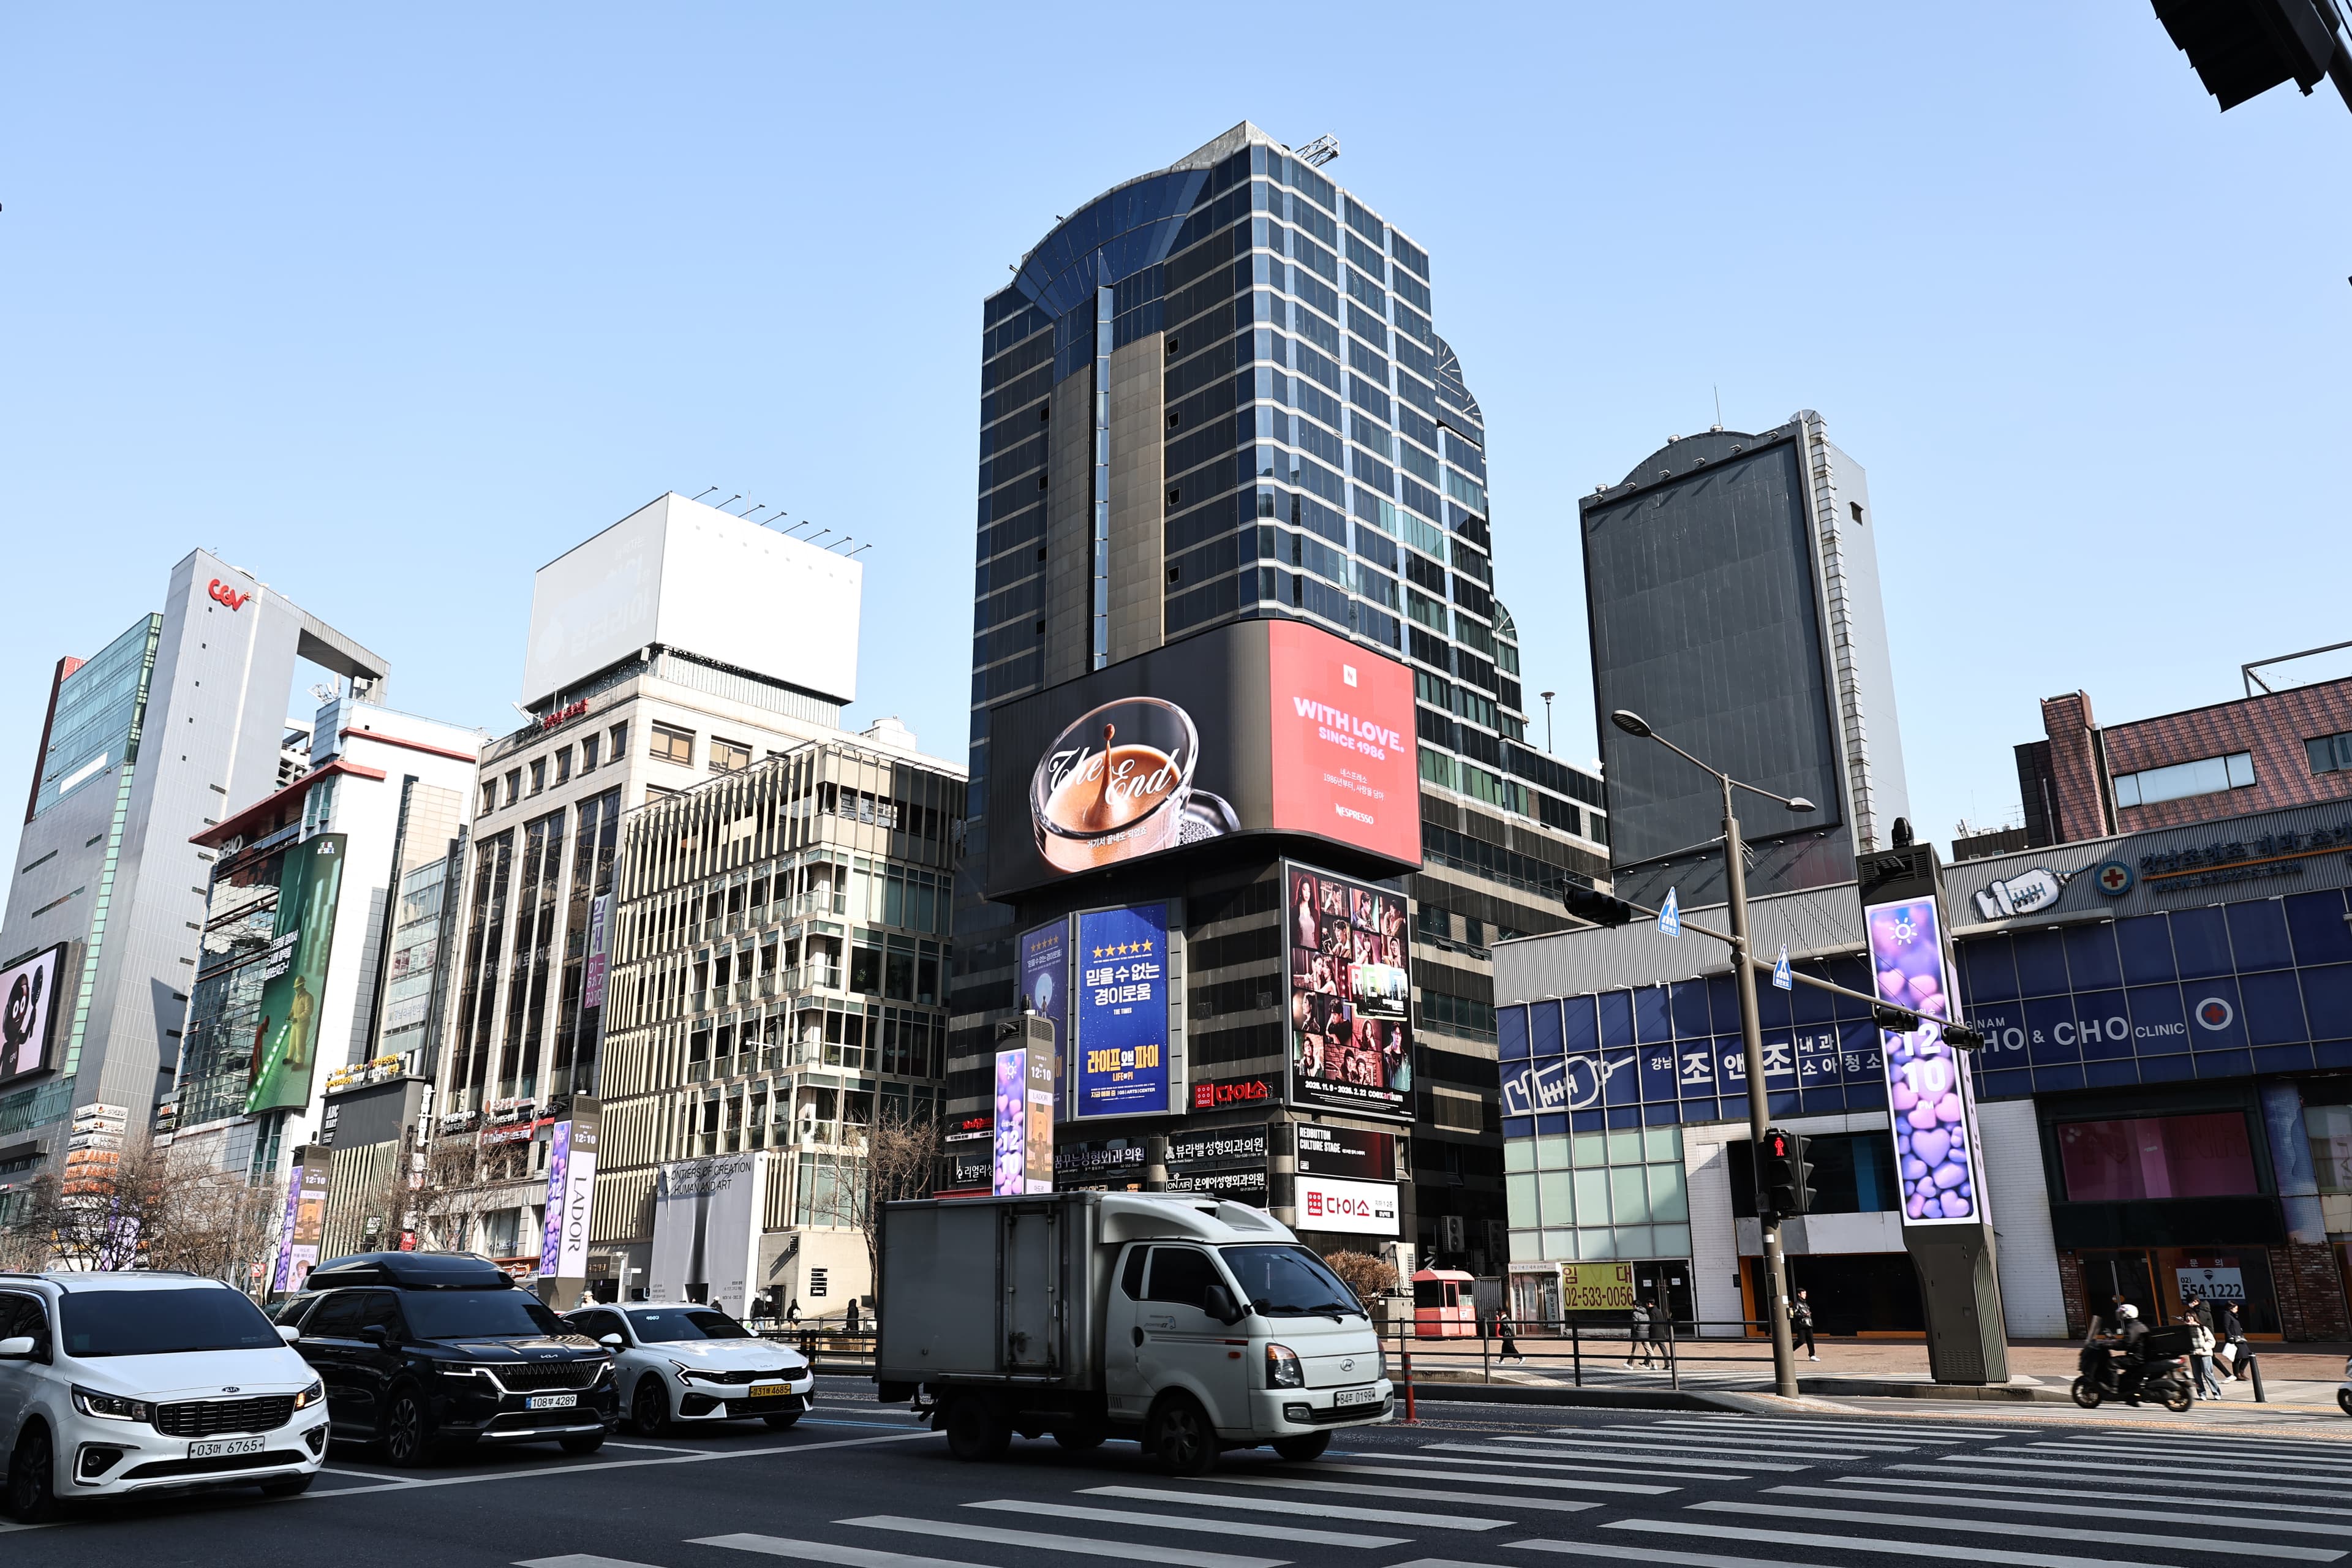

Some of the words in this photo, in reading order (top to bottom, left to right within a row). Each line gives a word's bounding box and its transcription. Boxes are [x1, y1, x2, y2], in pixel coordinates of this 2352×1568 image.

[208, 578, 245, 611] CGV
[1293, 696, 1349, 732] WITH
[1352, 716, 1404, 753] LOVE.
[1319, 726, 1355, 750] SINCE
[1357, 741, 1385, 760] 1986
[1048, 746, 1104, 792] The
[1105, 748, 1180, 805] End
[1340, 767, 1368, 784] 네스프레소
[1356, 785, 1373, 797] 사랑을
[1373, 788, 1384, 801] 담아
[1334, 802, 1374, 824] NESPRESSO
[217, 834, 243, 862] SPAO
[1087, 837, 1106, 850] 거기서
[1106, 831, 1126, 845] 끝내도
[1126, 826, 1148, 839] 되었죠
[1086, 967, 1114, 987] 믿을
[1115, 965, 1130, 982] 수
[1131, 962, 1160, 981] 없는
[1351, 965, 1404, 1001] RENT
[1094, 982, 1152, 1006] 경이로움
[1800, 1033, 1835, 1053] 내과
[1897, 1022, 1942, 1058] 12
[1968, 1027, 2025, 1055] HO
[2033, 1029, 2046, 1044] &
[2053, 1016, 2129, 1046] CHO
[2135, 1022, 2185, 1039] CLINIC
[1134, 1044, 1159, 1069] 파이
[1651, 1055, 1674, 1072] 강남
[1031, 1066, 1052, 1082] 12:10
[1901, 1058, 1947, 1093] 10
[1033, 1092, 1049, 1102] LADOR
[1216, 1080, 1268, 1102] 다이소
[1368, 1090, 1403, 1102] coexartium
[1917, 1100, 1934, 1110] PM
[574, 1133, 597, 1145] 12:10
[1000, 1131, 1020, 1152] 12
[1299, 1126, 1331, 1140] REDBUTTON
[1299, 1139, 1324, 1152] CULTURE
[1324, 1142, 1341, 1153] STAGE
[662, 1165, 701, 1182] FONTIERS
[702, 1166, 713, 1177] OF
[714, 1161, 752, 1176] CREATION
[1001, 1154, 1020, 1175] 10
[305, 1175, 326, 1185] 12:10
[674, 1183, 700, 1196] HUMAN
[701, 1182, 717, 1193] AND
[716, 1179, 733, 1190] ART
[1167, 1180, 1178, 1189] ON
[1194, 1172, 1265, 1191] 온에어성형외과의원
[567, 1176, 587, 1253] LADOR
[1327, 1197, 1370, 1217] 다이소
[1564, 1286, 1634, 1307] 02-533-0056
[771, 1385, 788, 1395] 4685
[1355, 1391, 1372, 1402] 0198
[532, 1398, 554, 1408] 108부
[555, 1396, 576, 1406] 4289
[197, 1444, 222, 1457] 03머
[226, 1439, 258, 1453] 6765
